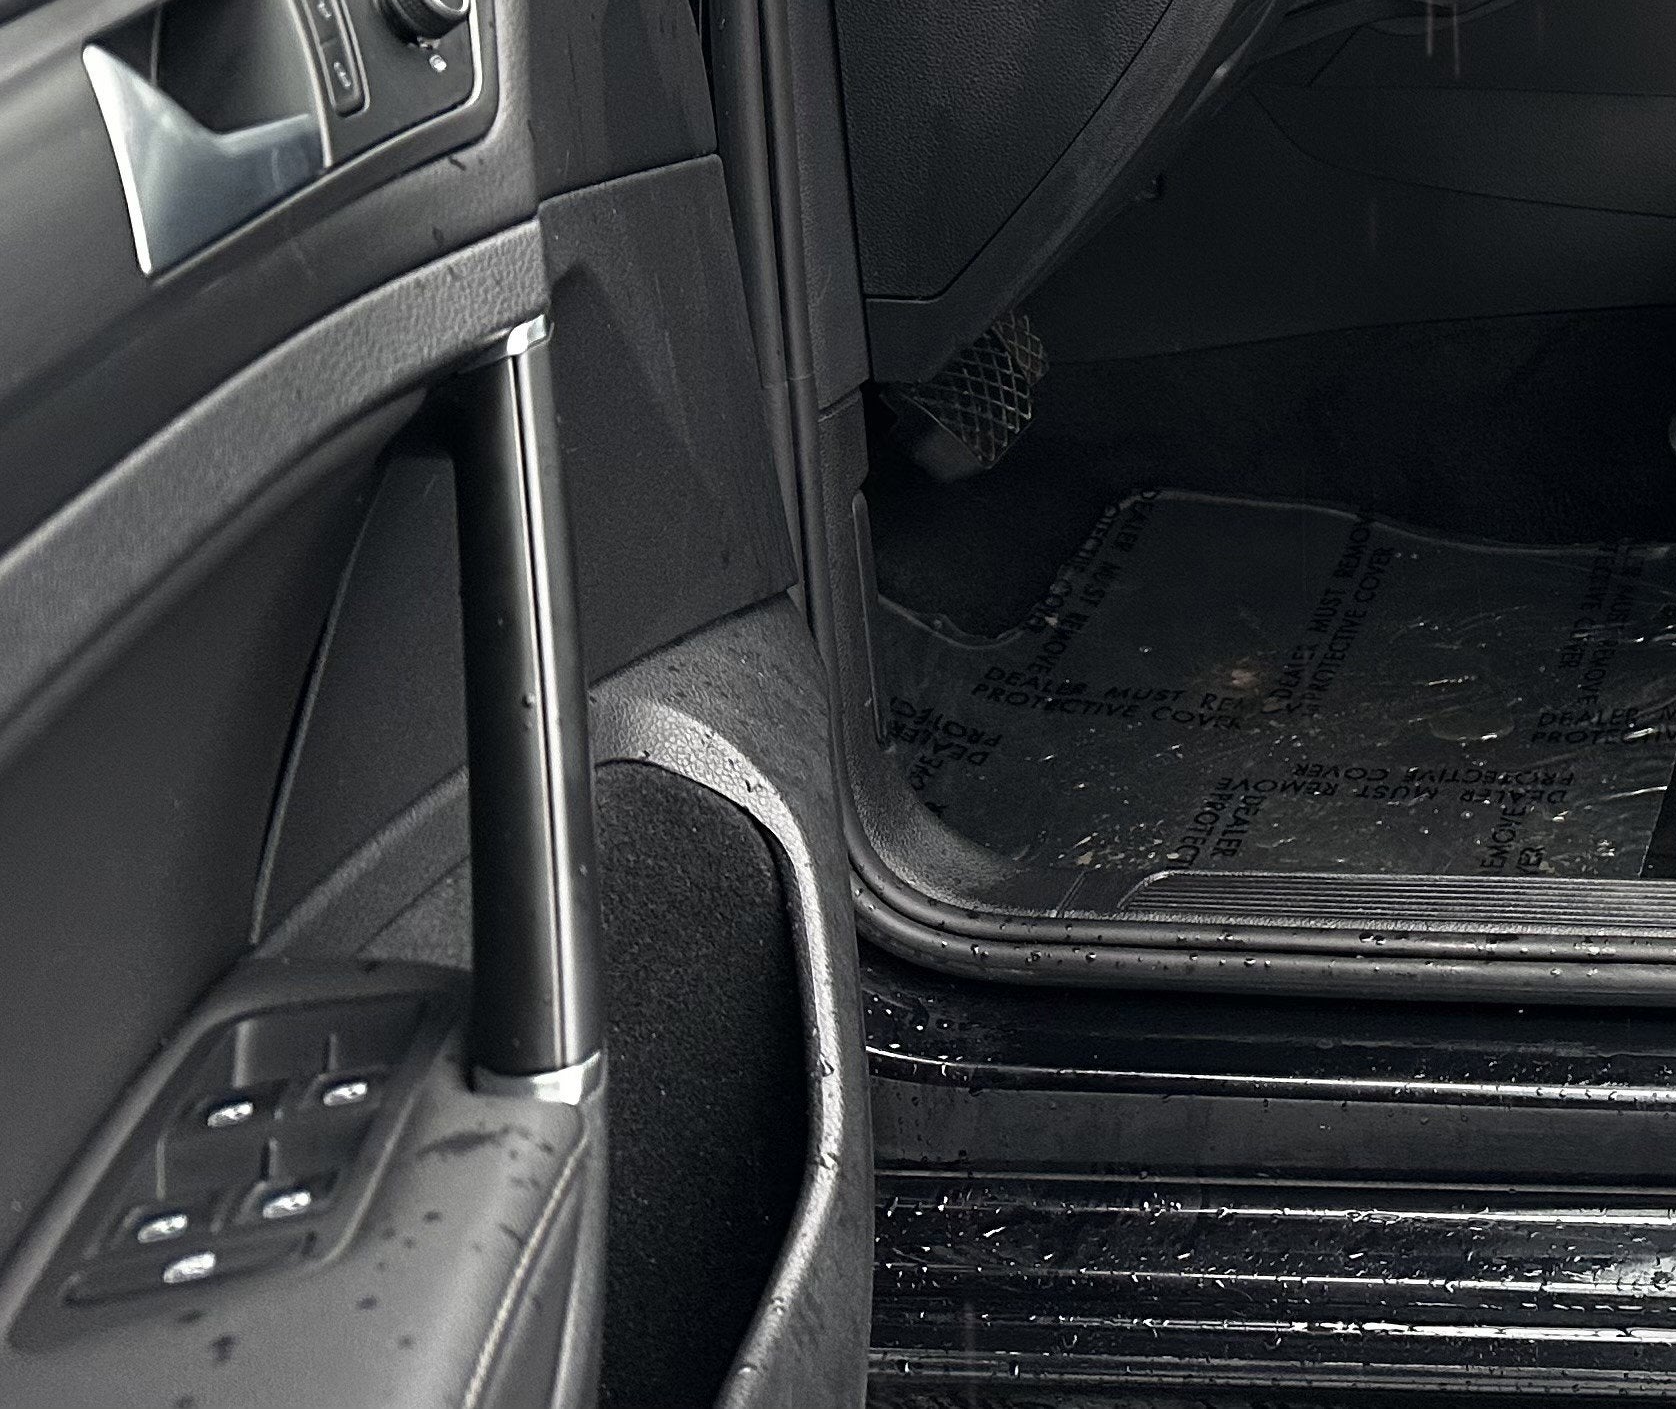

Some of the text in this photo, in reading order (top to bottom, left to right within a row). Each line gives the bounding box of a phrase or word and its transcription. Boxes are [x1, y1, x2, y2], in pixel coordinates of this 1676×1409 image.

[1354, 546, 1395, 604] COVER
[1308, 589, 1345, 633] MUST
[971, 682, 1138, 718] PROTECTIVE
[1104, 687, 1184, 703] MUST
[1216, 776, 1340, 797] REMOVE
[1296, 763, 1390, 782] COVER
[1210, 793, 1268, 857] DEALER
